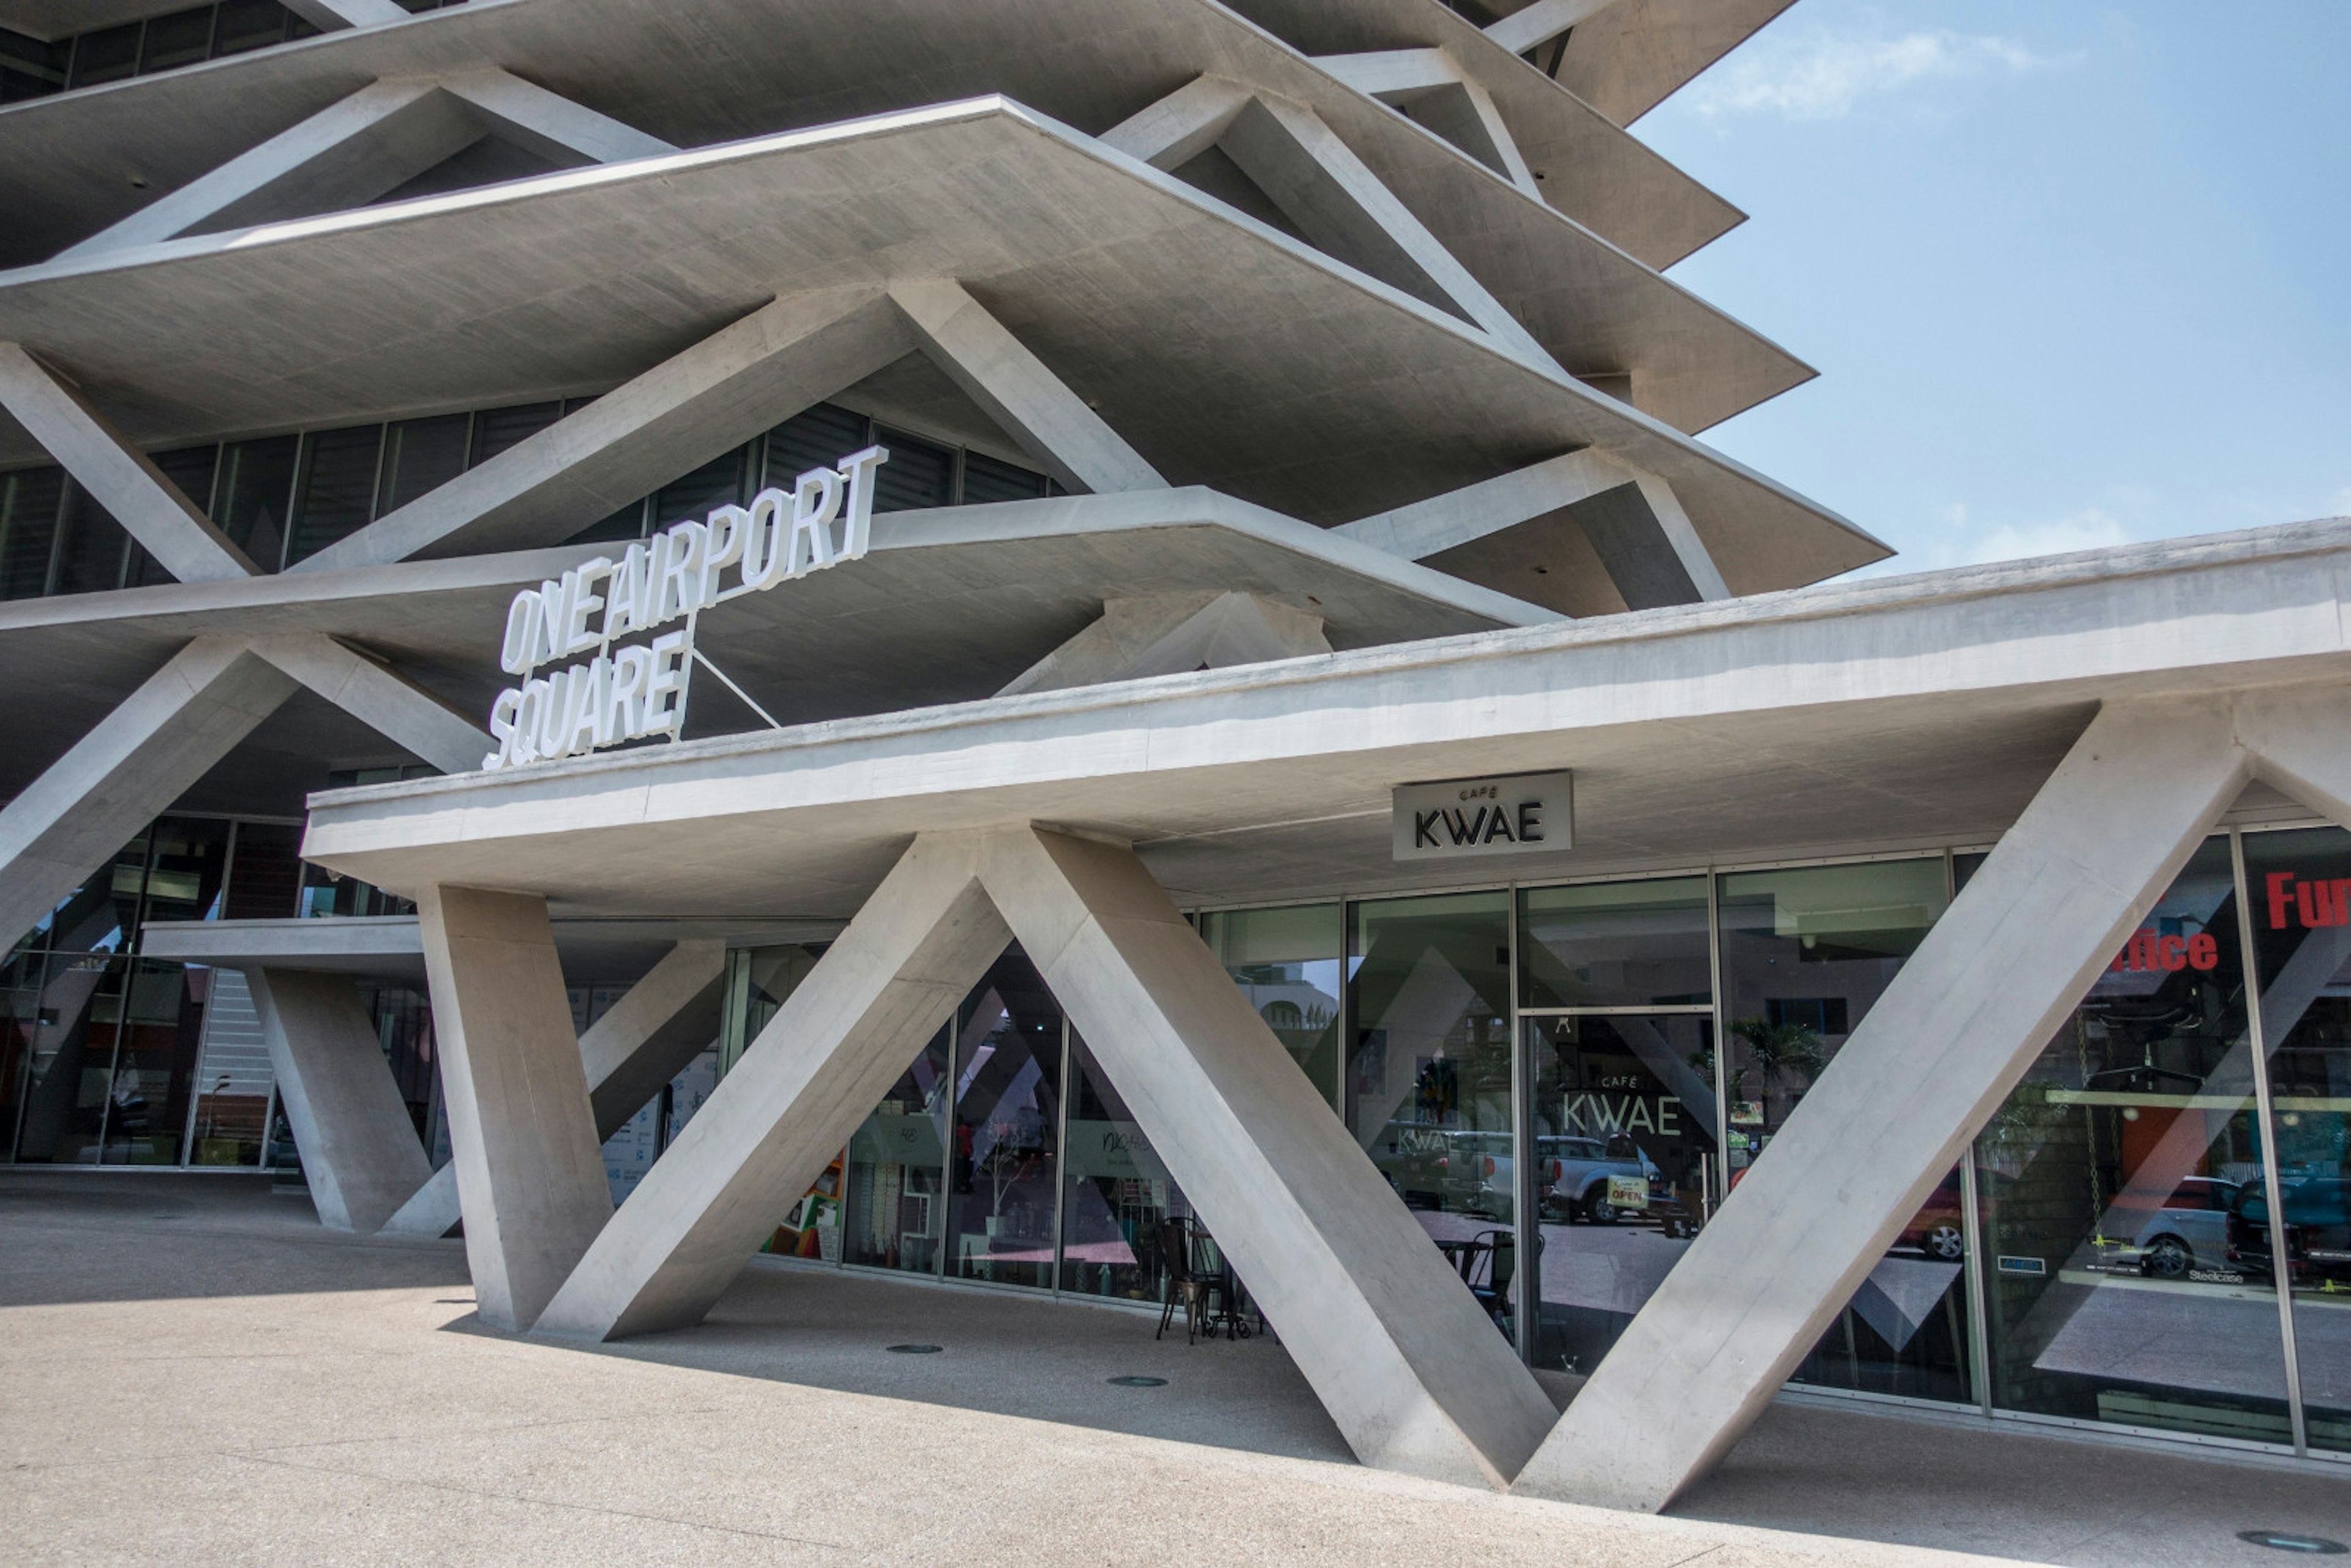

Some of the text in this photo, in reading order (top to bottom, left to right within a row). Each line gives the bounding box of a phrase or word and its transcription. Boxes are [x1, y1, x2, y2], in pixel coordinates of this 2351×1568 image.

[500, 444, 890, 675] ONE AIRPORT
[481, 629, 694, 771] SQUARE
[1415, 801, 1546, 850] KWAE
[1600, 1075, 1638, 1089] CAFÉ
[1562, 1092, 1682, 1137] KWAE
[1612, 1190, 1643, 1202] OPEN
[2188, 1268, 2244, 1284] Steelcase
